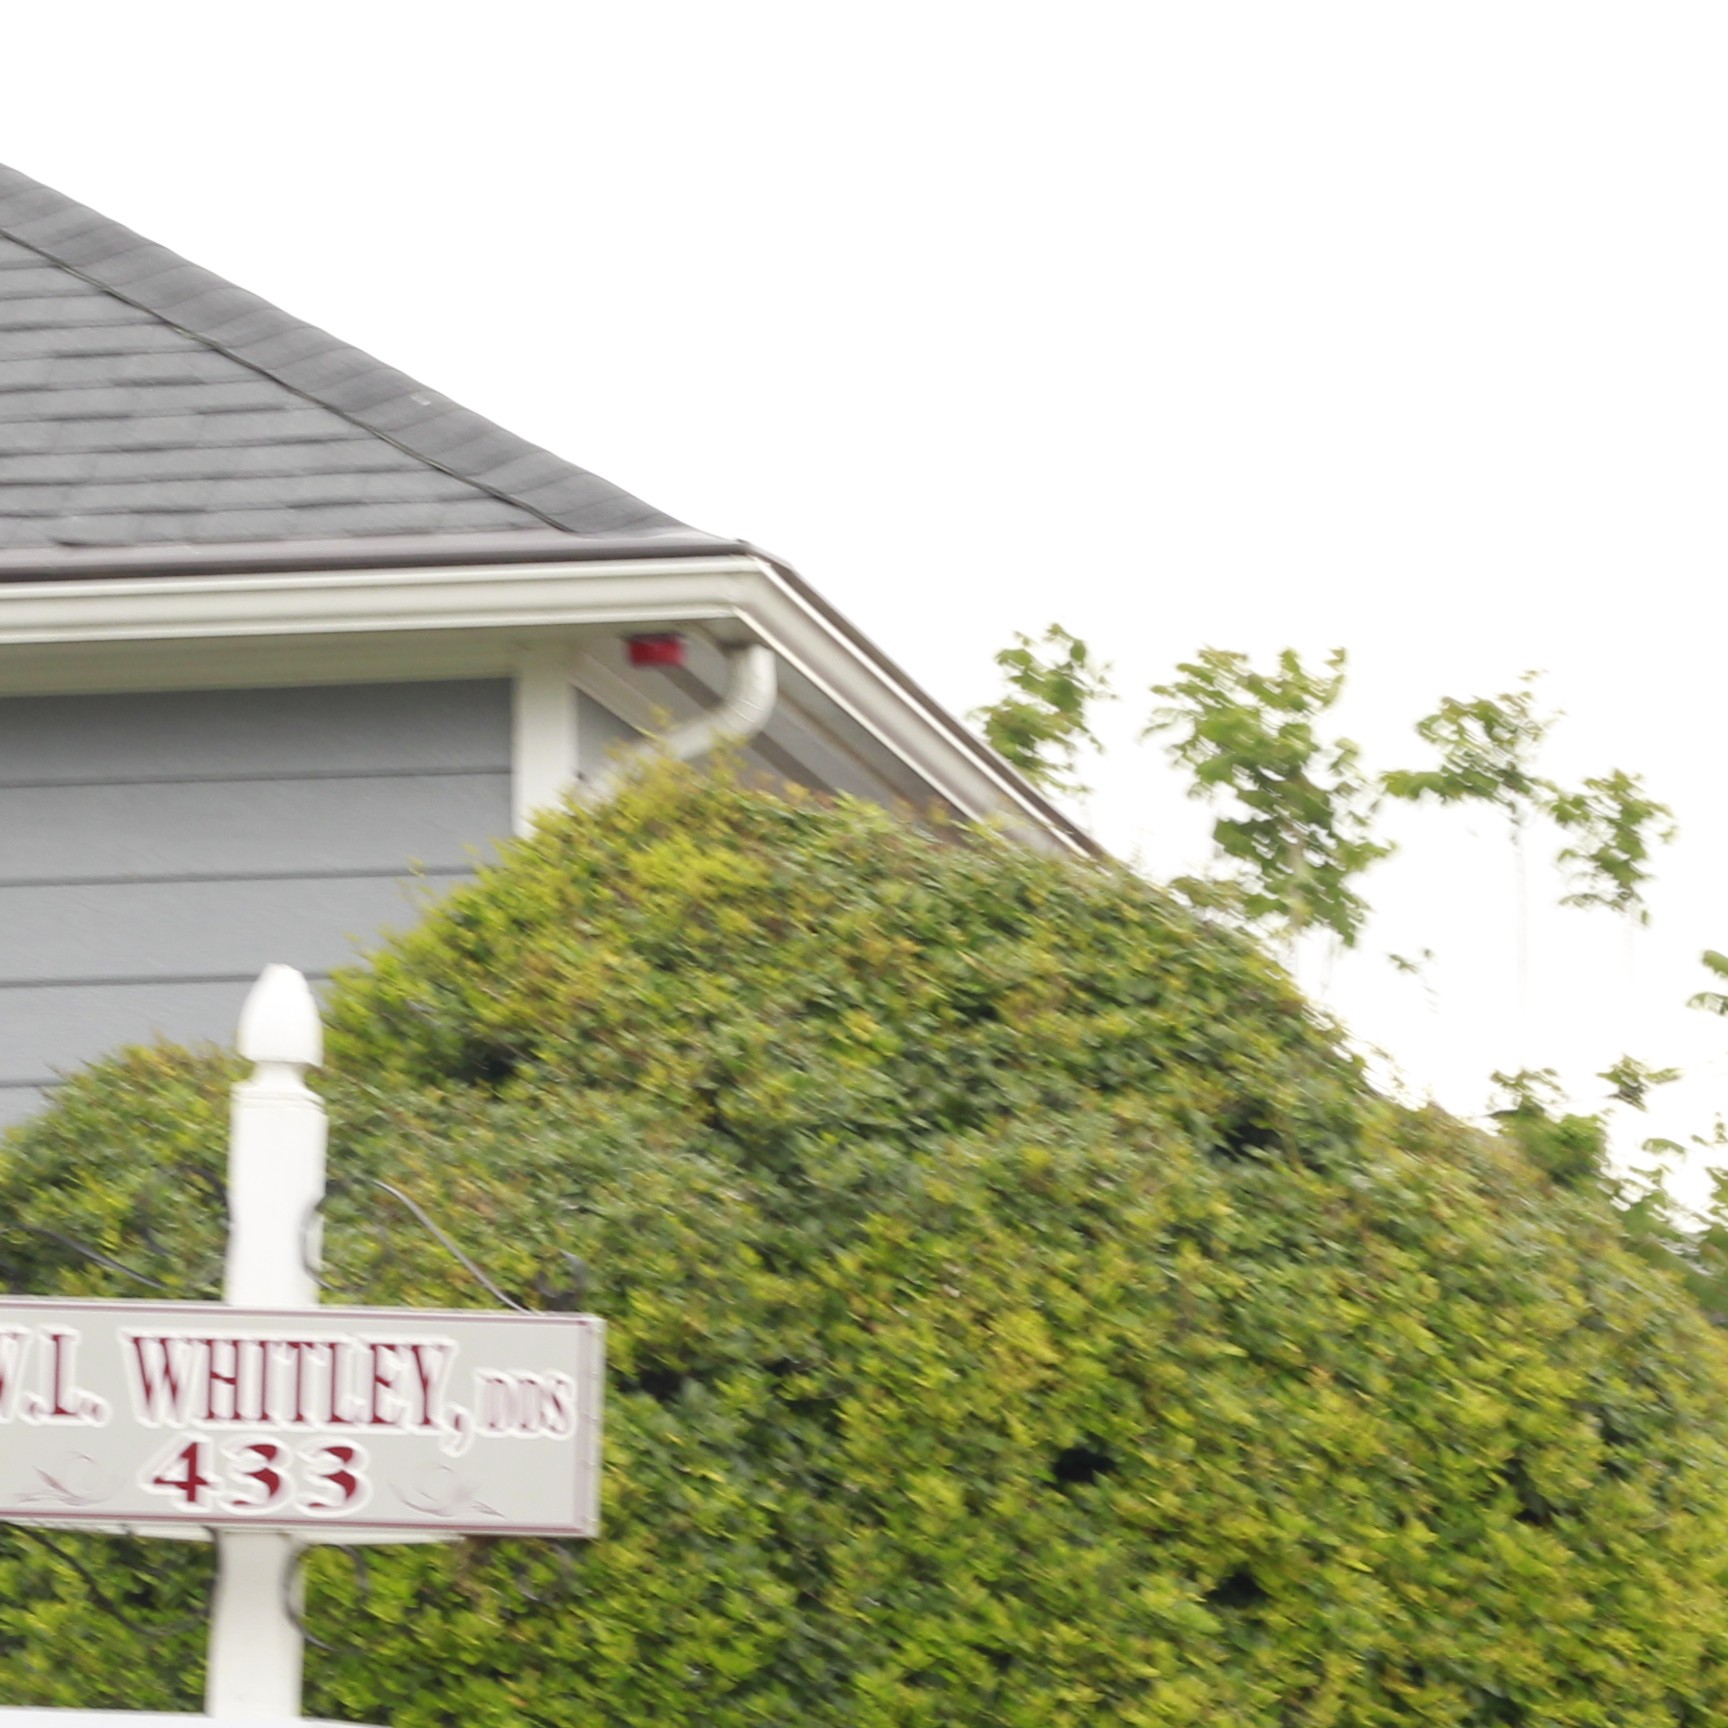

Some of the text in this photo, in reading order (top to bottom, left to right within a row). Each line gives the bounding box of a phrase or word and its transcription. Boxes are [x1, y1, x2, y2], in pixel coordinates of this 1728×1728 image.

[120, 1331, 468, 1453] WHITLEY,
[476, 1370, 573, 1438] DDS
[145, 1436, 367, 1512] 433
